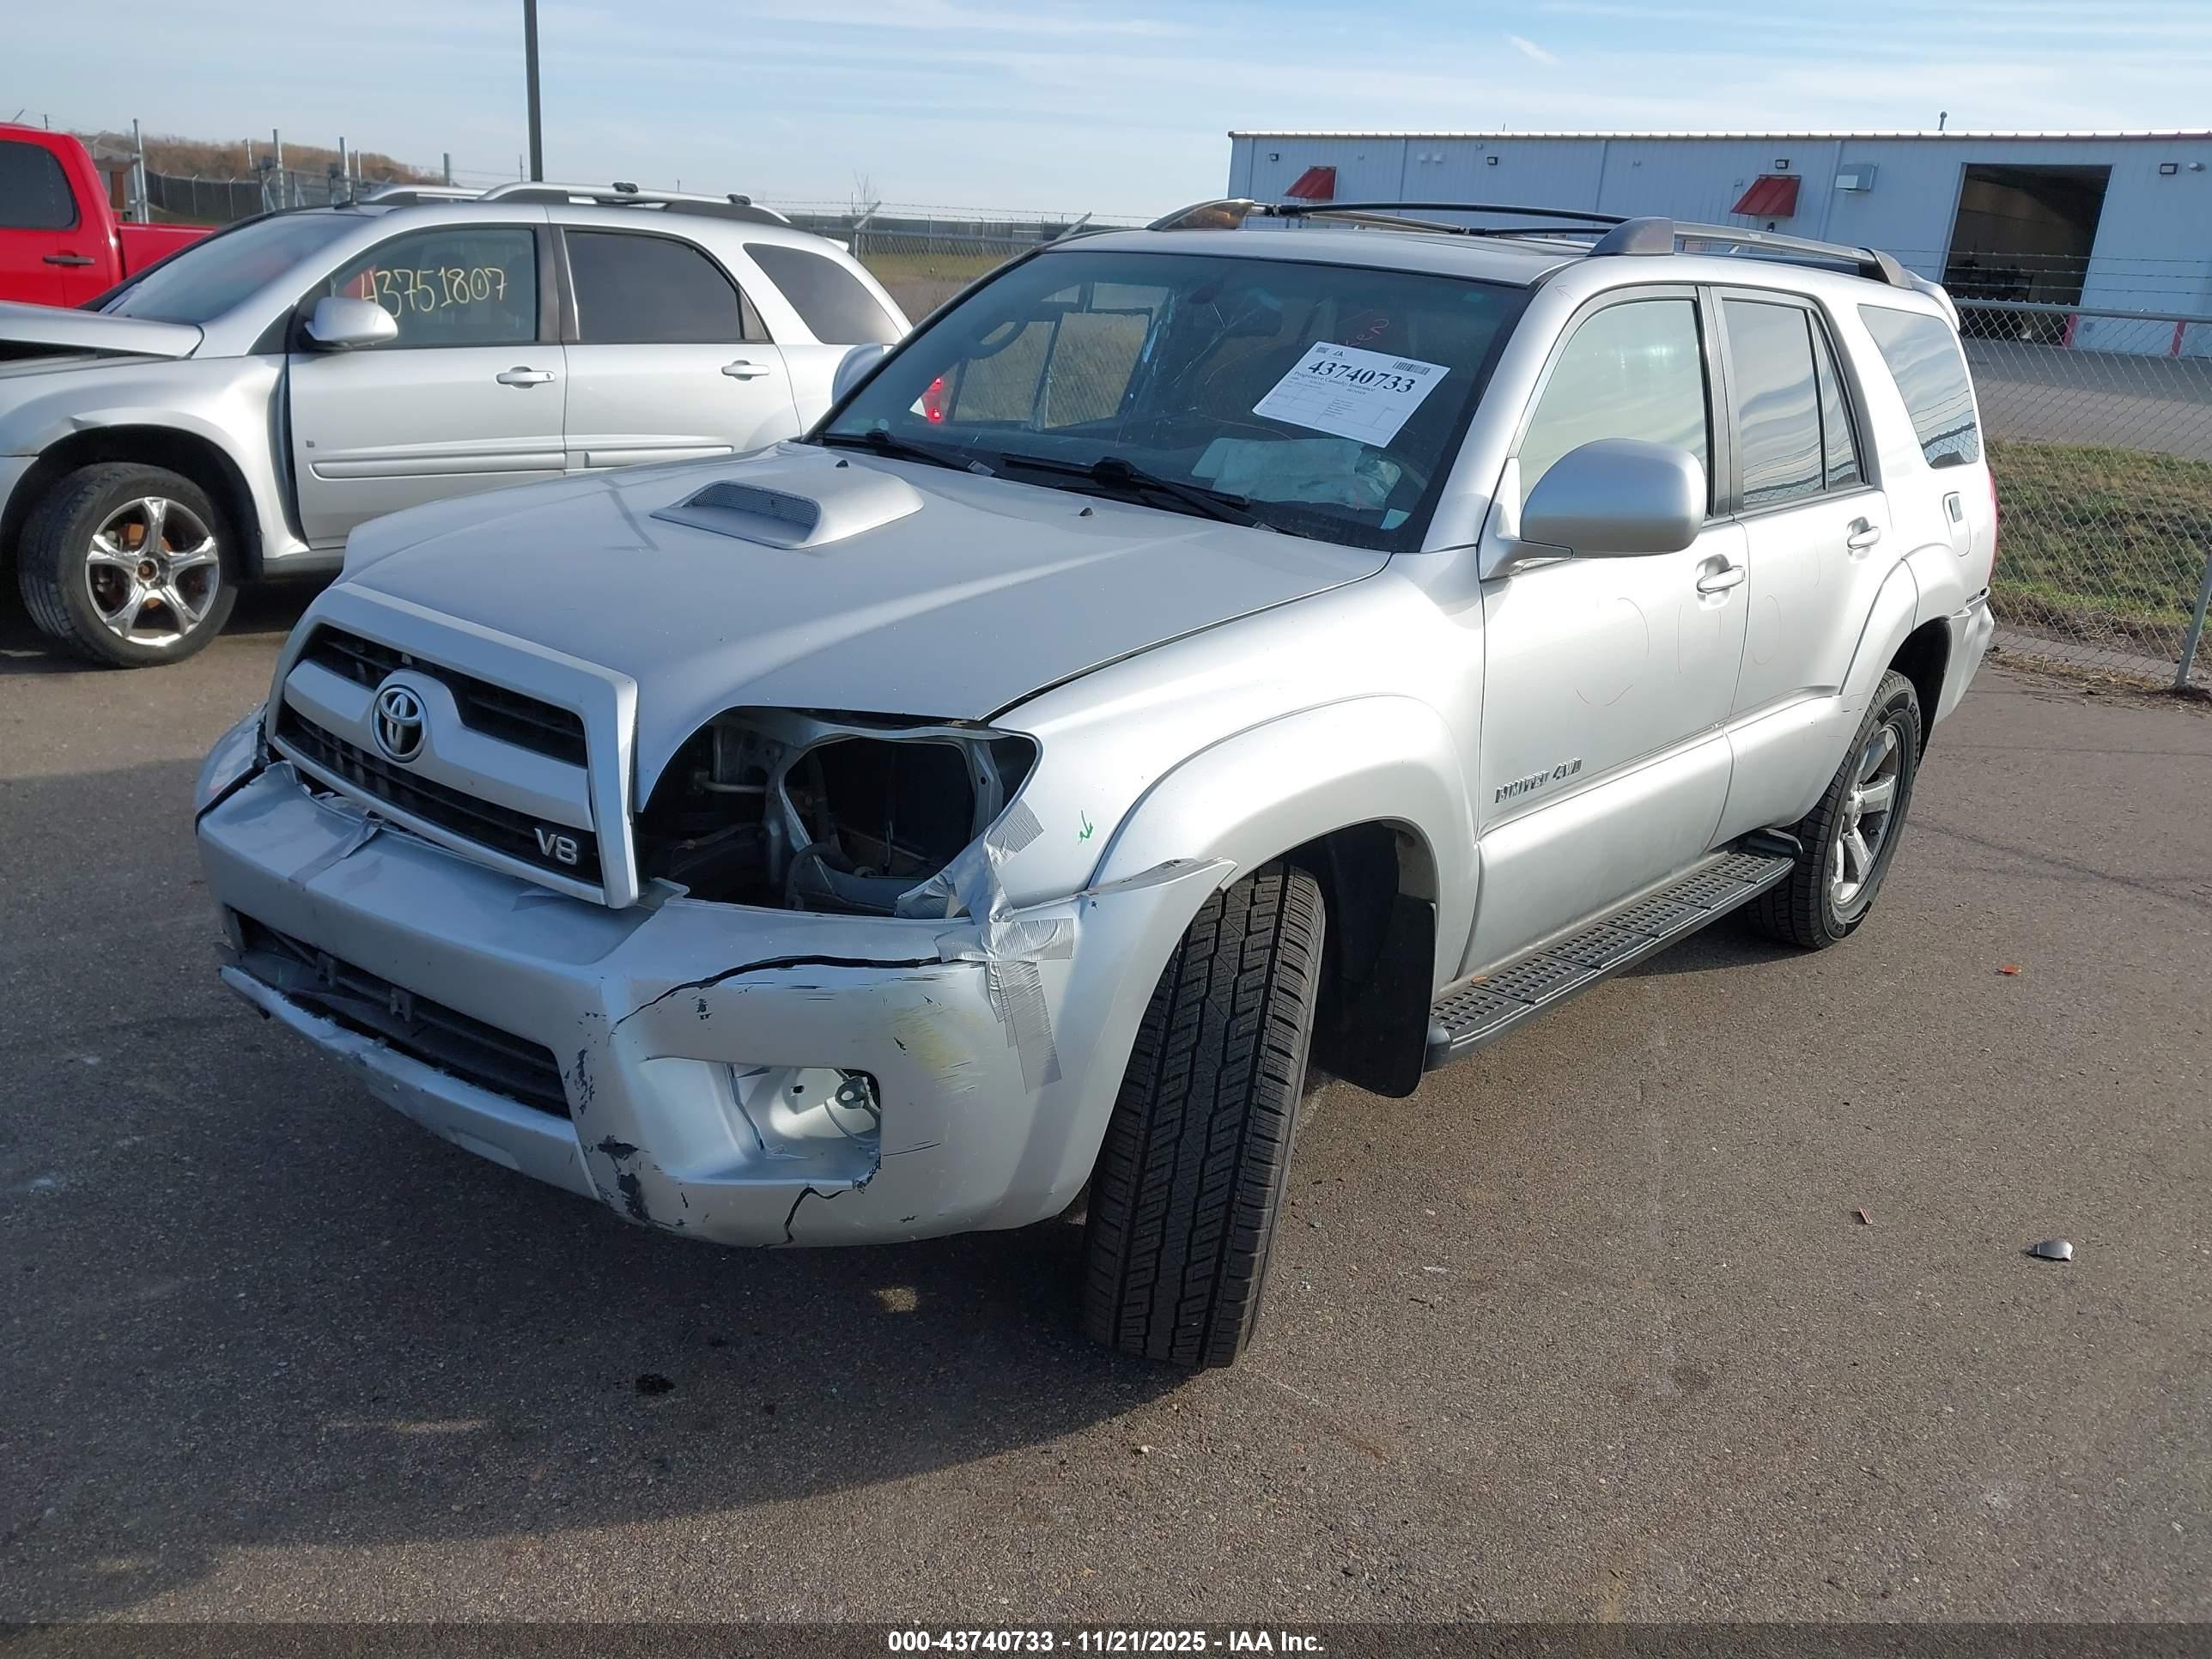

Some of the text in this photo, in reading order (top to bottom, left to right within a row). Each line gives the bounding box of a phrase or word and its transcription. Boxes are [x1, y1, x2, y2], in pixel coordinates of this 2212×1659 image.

[361, 266, 507, 319] 43751807
[1308, 360, 1416, 393] 43740733
[1552, 757, 1583, 781] 4WD
[534, 827, 578, 866] V8
